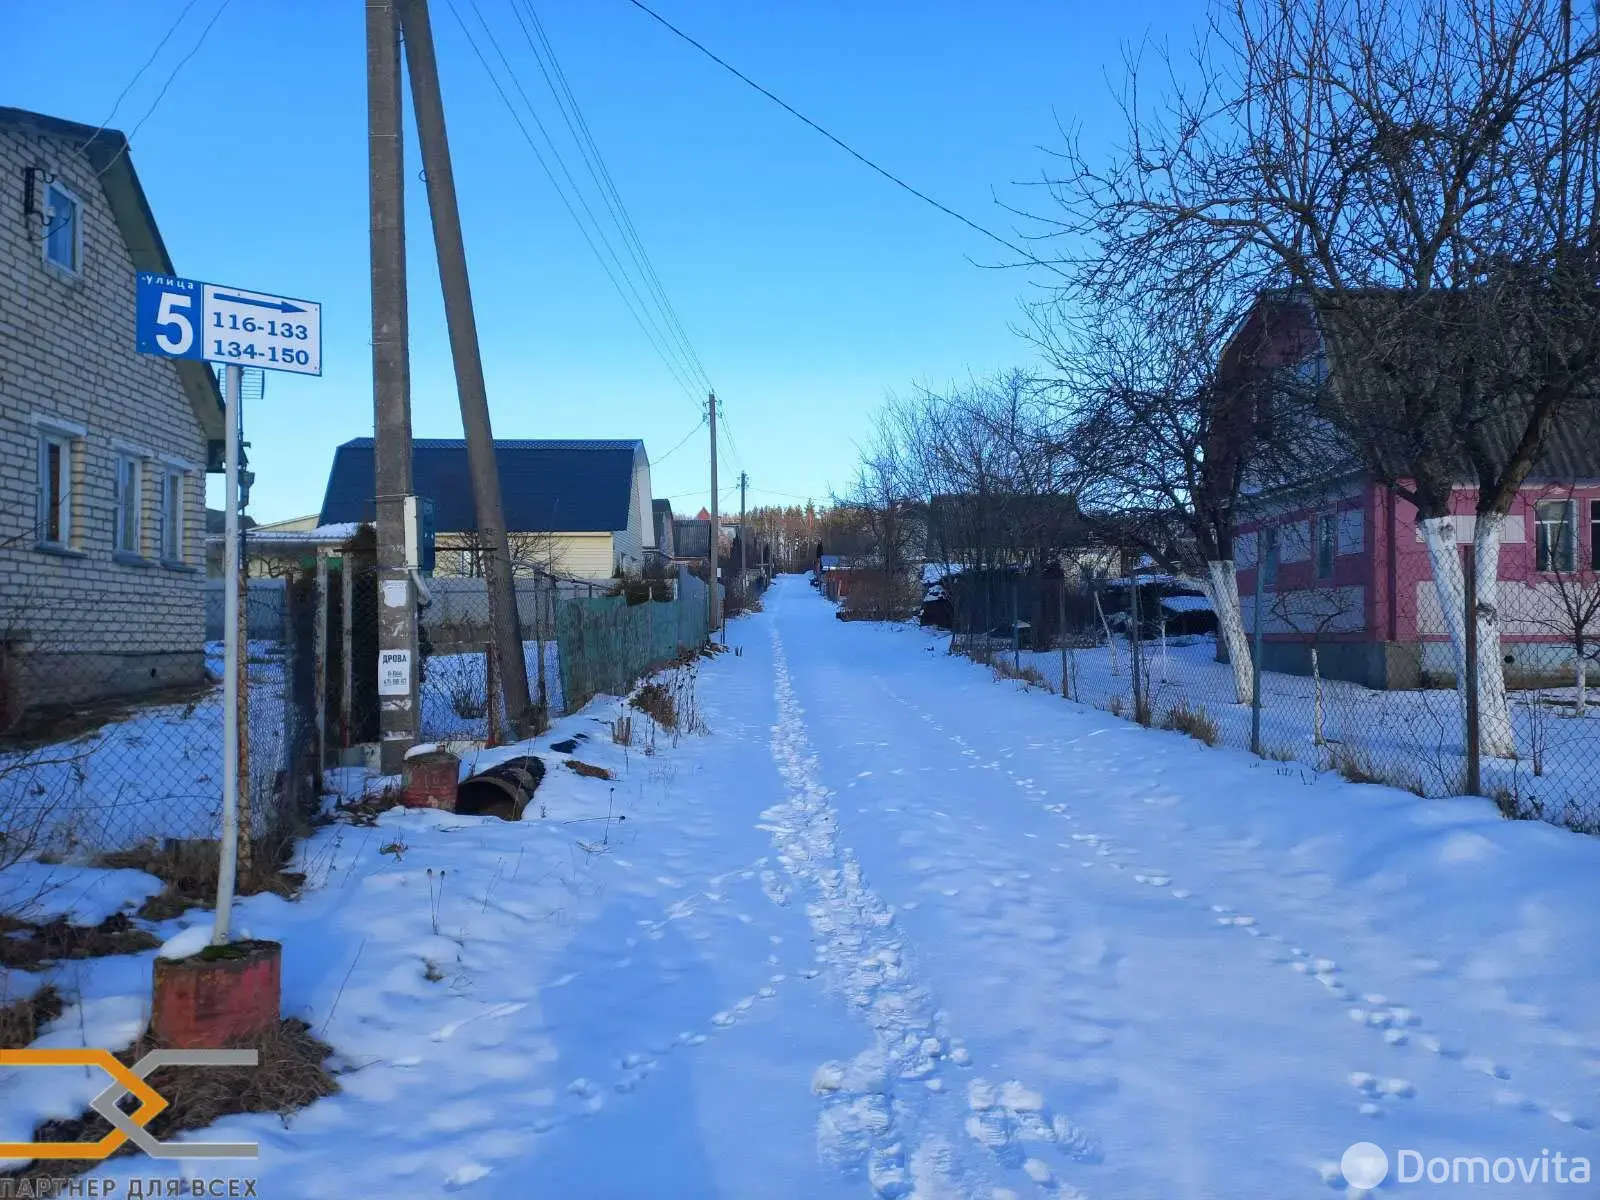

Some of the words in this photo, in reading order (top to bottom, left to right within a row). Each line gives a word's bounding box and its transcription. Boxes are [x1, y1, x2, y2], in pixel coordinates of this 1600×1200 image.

[146, 275, 194, 290] улица
[156, 292, 194, 355] 5
[212, 311, 308, 340] 116-133
[213, 340, 309, 366] 134-150
[382, 654, 407, 664] ДРОВА
